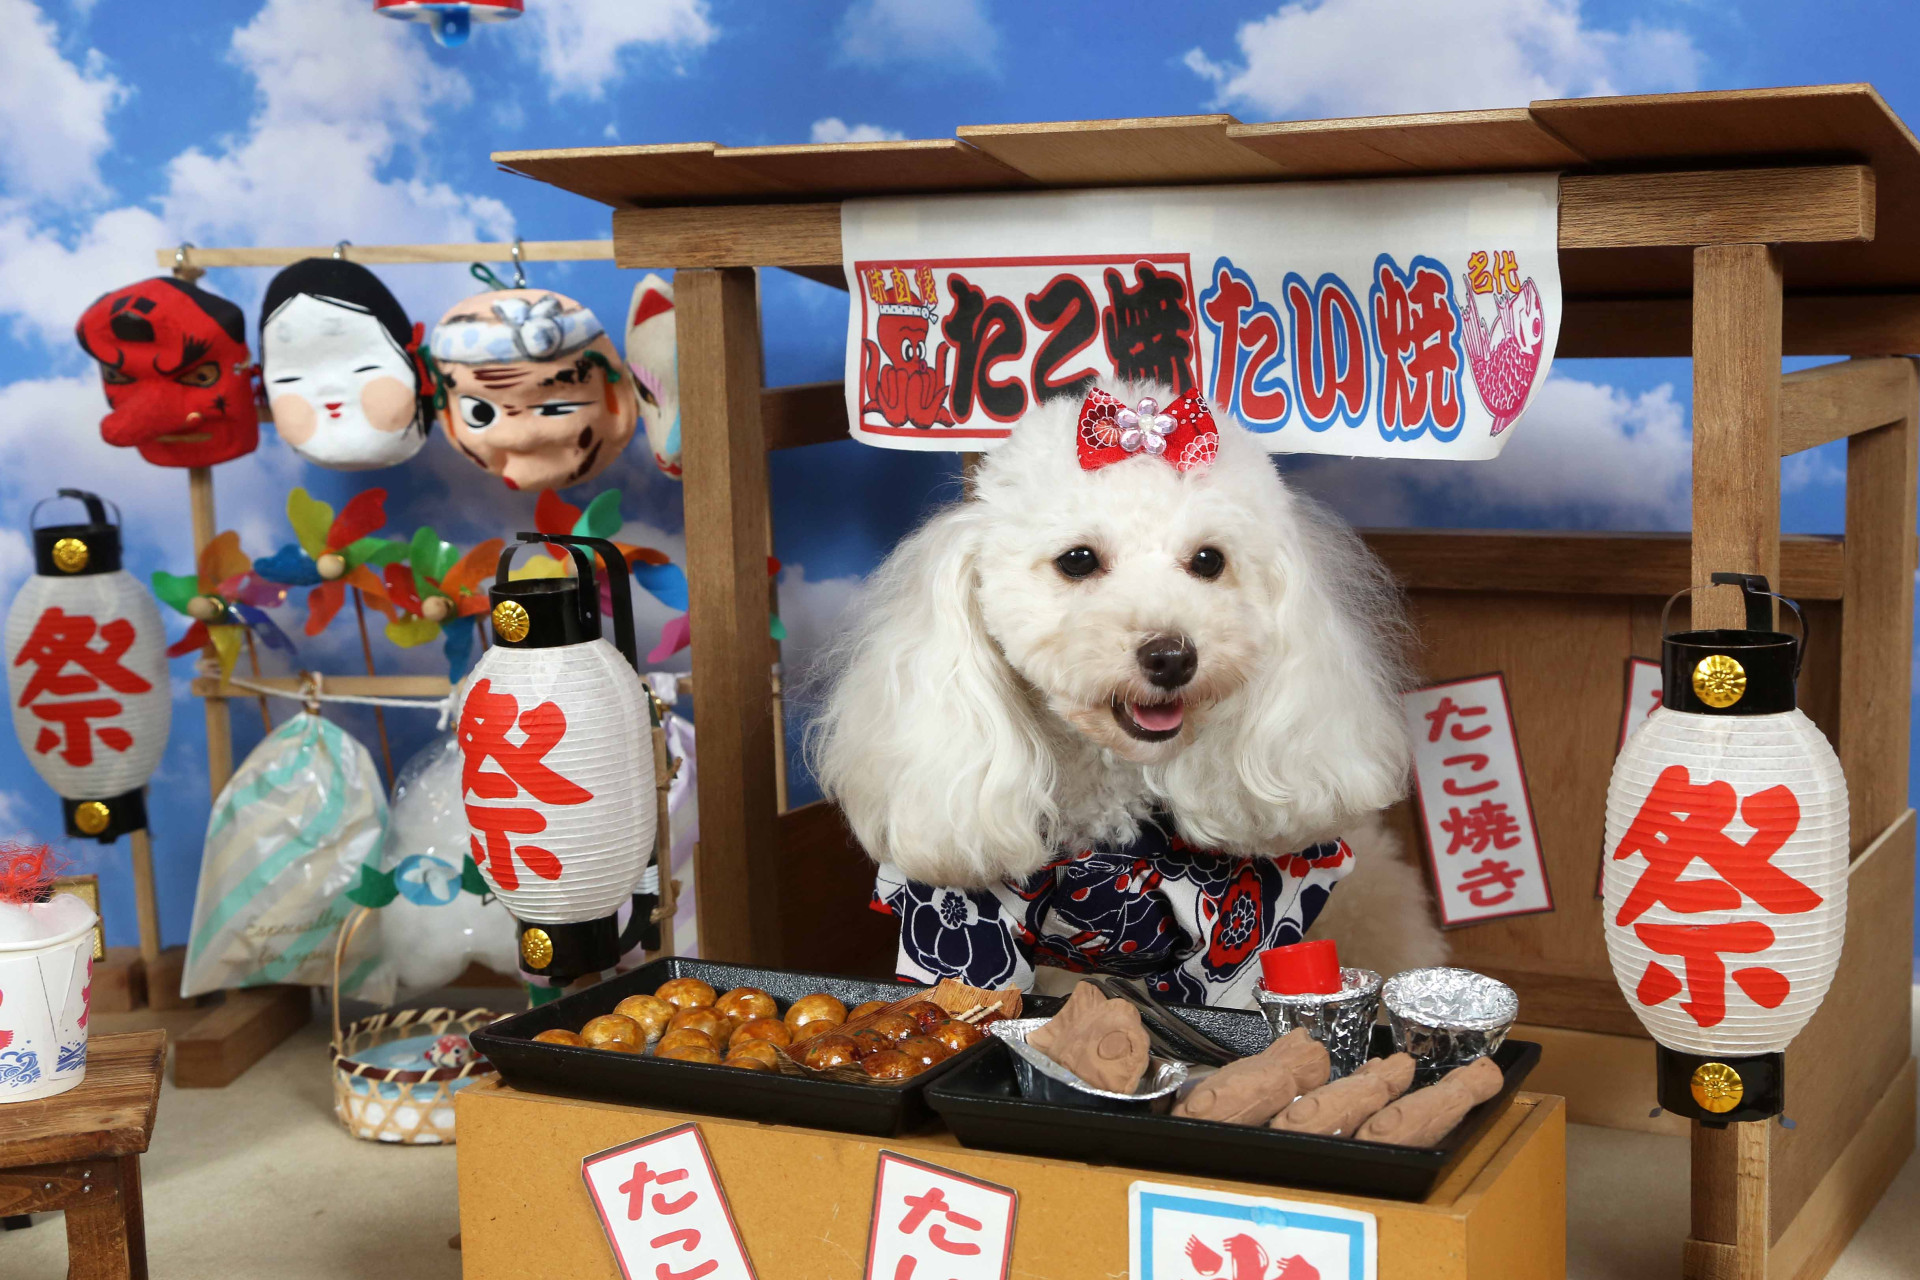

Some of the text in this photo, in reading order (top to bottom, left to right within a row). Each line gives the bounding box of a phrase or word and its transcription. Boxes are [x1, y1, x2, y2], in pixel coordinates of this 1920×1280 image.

[1200, 252, 1464, 442] たい焼
[1468, 250, 1521, 295] 名代
[14, 606, 154, 767] 祭
[457, 678, 594, 891] 祭
[1424, 697, 1526, 908] たこ焼き
[1612, 764, 1824, 1028] 祭
